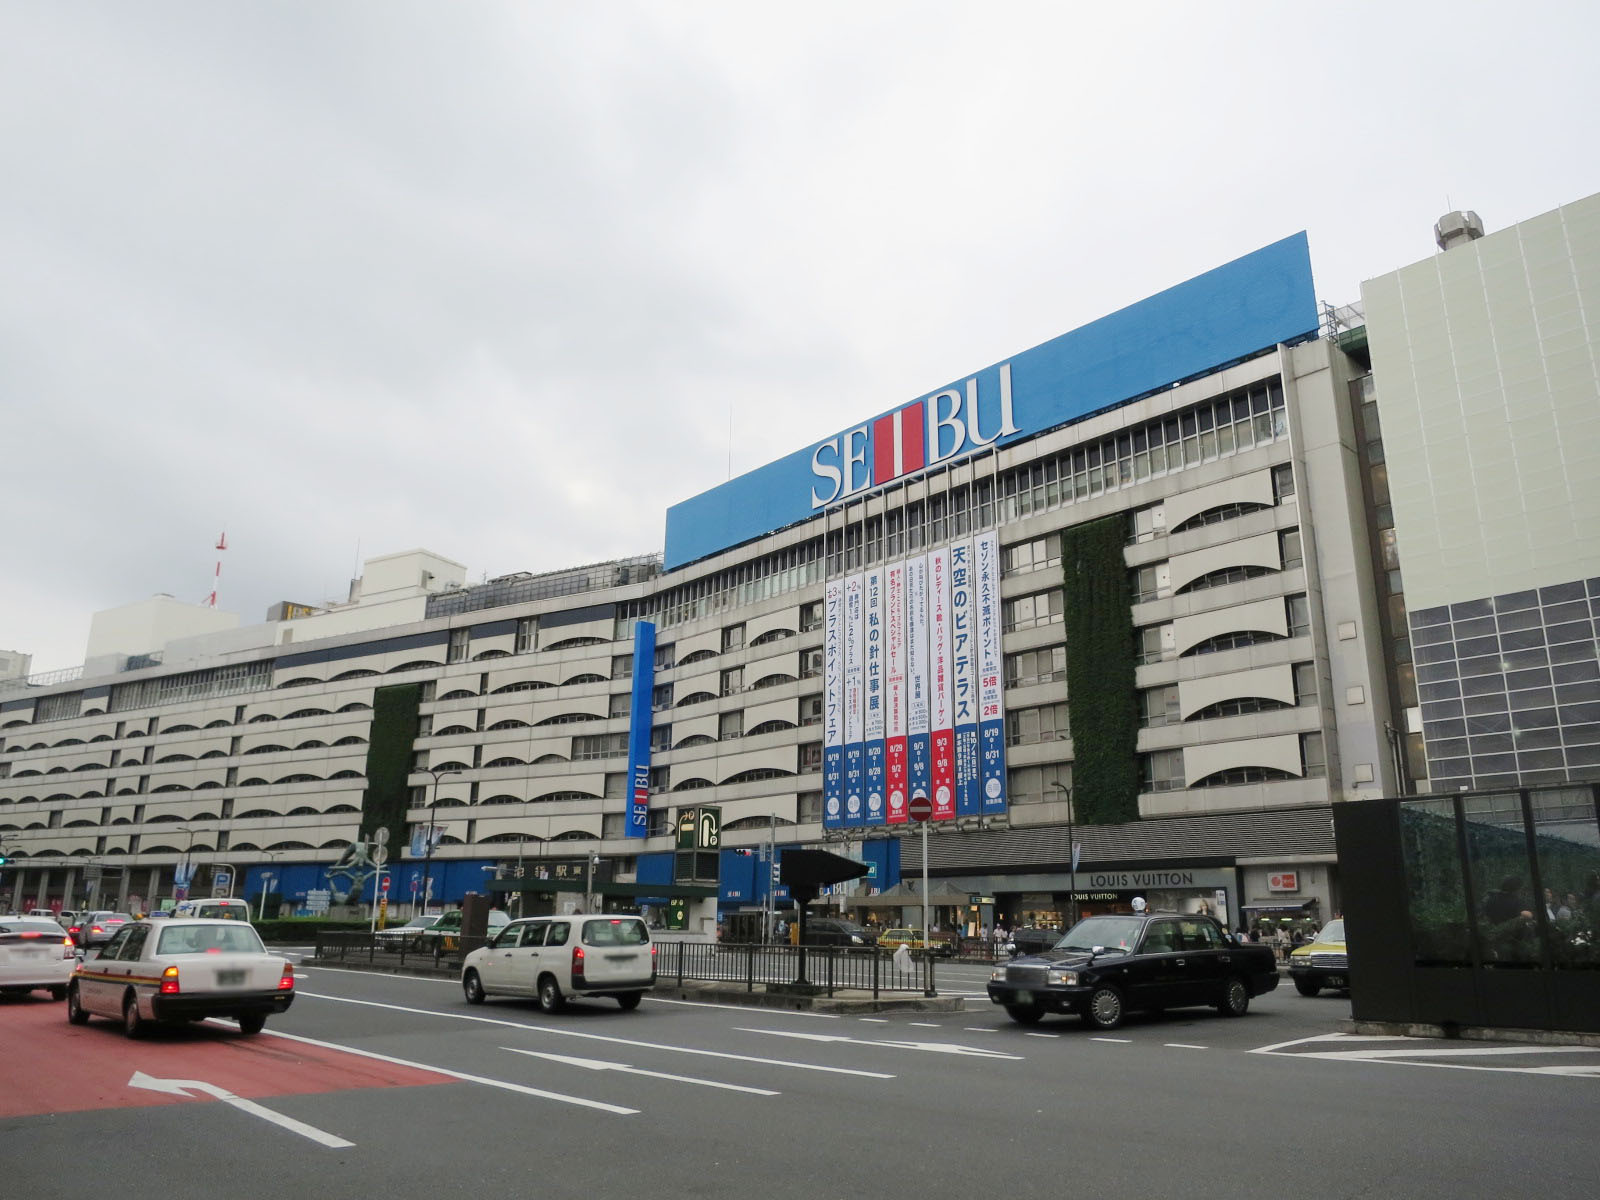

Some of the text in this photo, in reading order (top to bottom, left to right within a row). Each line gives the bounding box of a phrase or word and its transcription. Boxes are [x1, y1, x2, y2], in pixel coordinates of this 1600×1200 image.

[811, 362, 1023, 509] SEIBU
[870, 575, 878, 608] 第12回
[952, 546, 969, 718] 天空のビアテラス
[869, 612, 879, 710] 私の針仕事展
[827, 599, 837, 743] プラスポイントフェア
[983, 676, 997, 688] 5倍
[984, 704, 998, 716] 2倍
[984, 728, 999, 738] 8/19
[913, 741, 924, 750] 9/3
[937, 738, 947, 747] 9/3
[985, 750, 999, 759] 8/31
[937, 759, 948, 767] 9/8
[632, 764, 649, 826] SEIBU
[1090, 873, 1193, 887] LOUIS VUITTON
